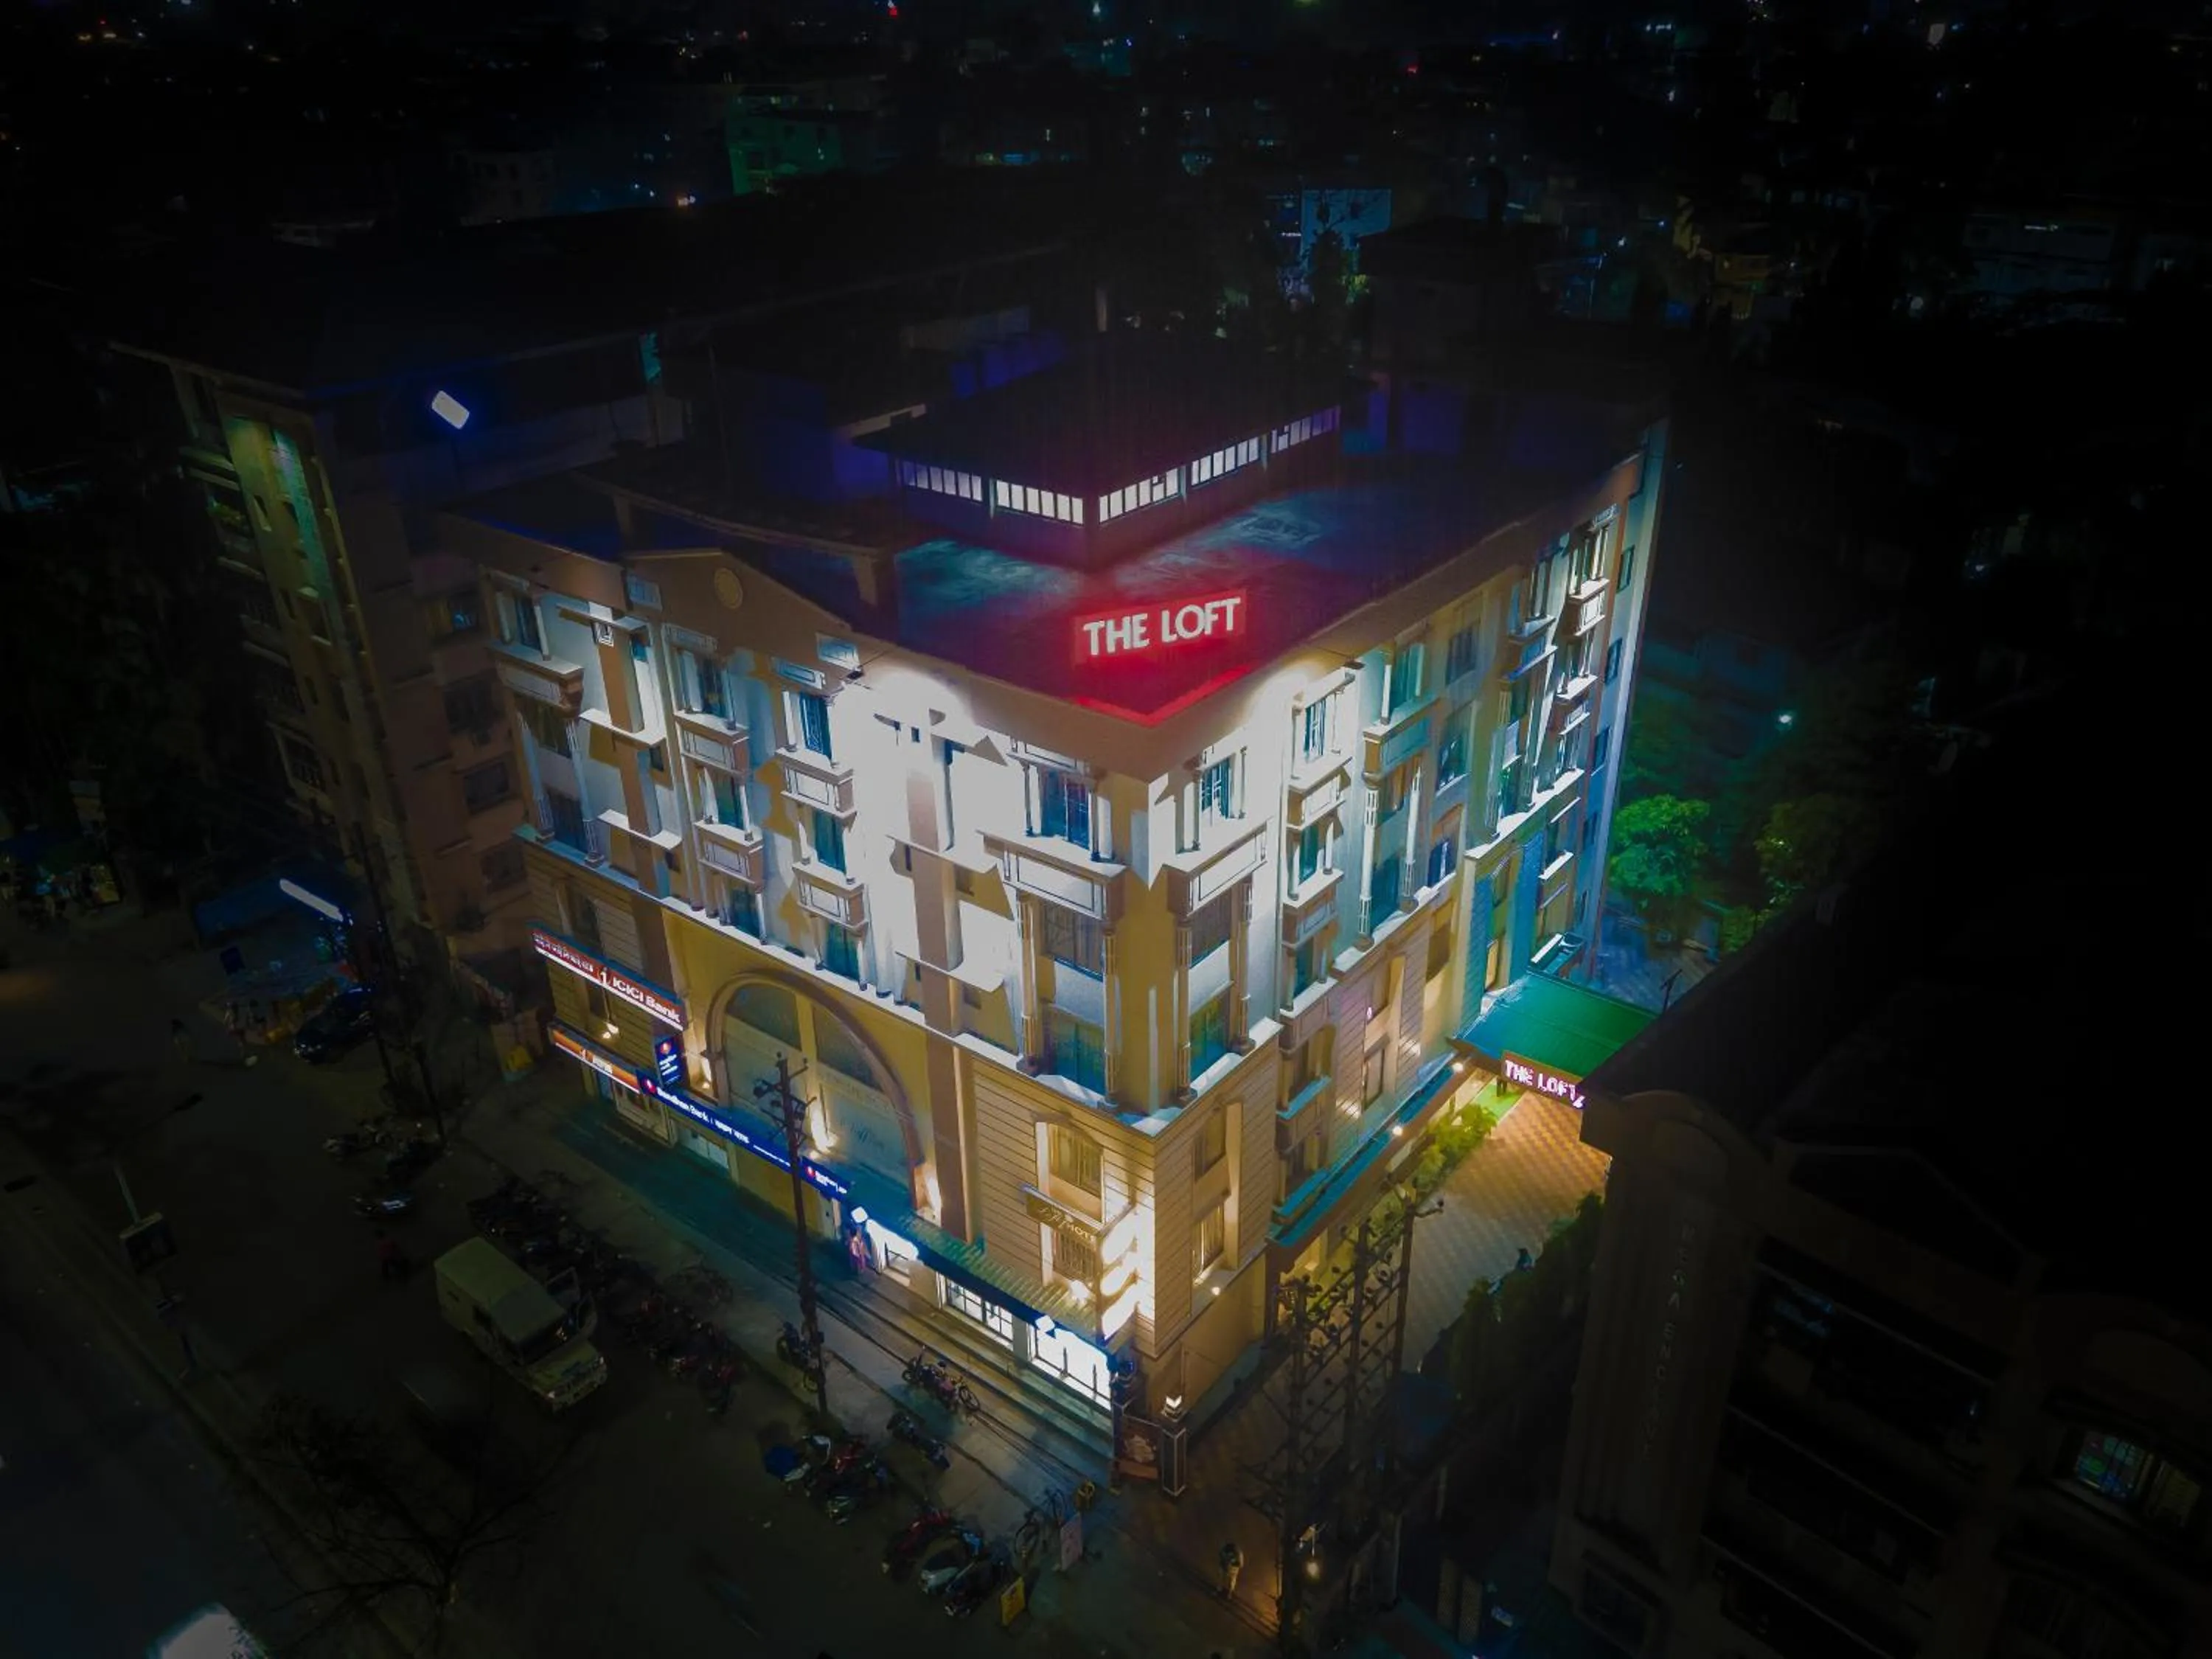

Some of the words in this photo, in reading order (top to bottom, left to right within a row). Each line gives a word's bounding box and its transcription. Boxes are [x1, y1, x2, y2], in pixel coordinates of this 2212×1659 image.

[1083, 613, 1150, 655] THE
[1161, 597, 1242, 644] LOFT
[613, 977, 644, 1001] ICICI
[645, 995, 681, 1023] Bank
[1505, 1060, 1534, 1086] THE
[1537, 1073, 1576, 1101] LOFT
